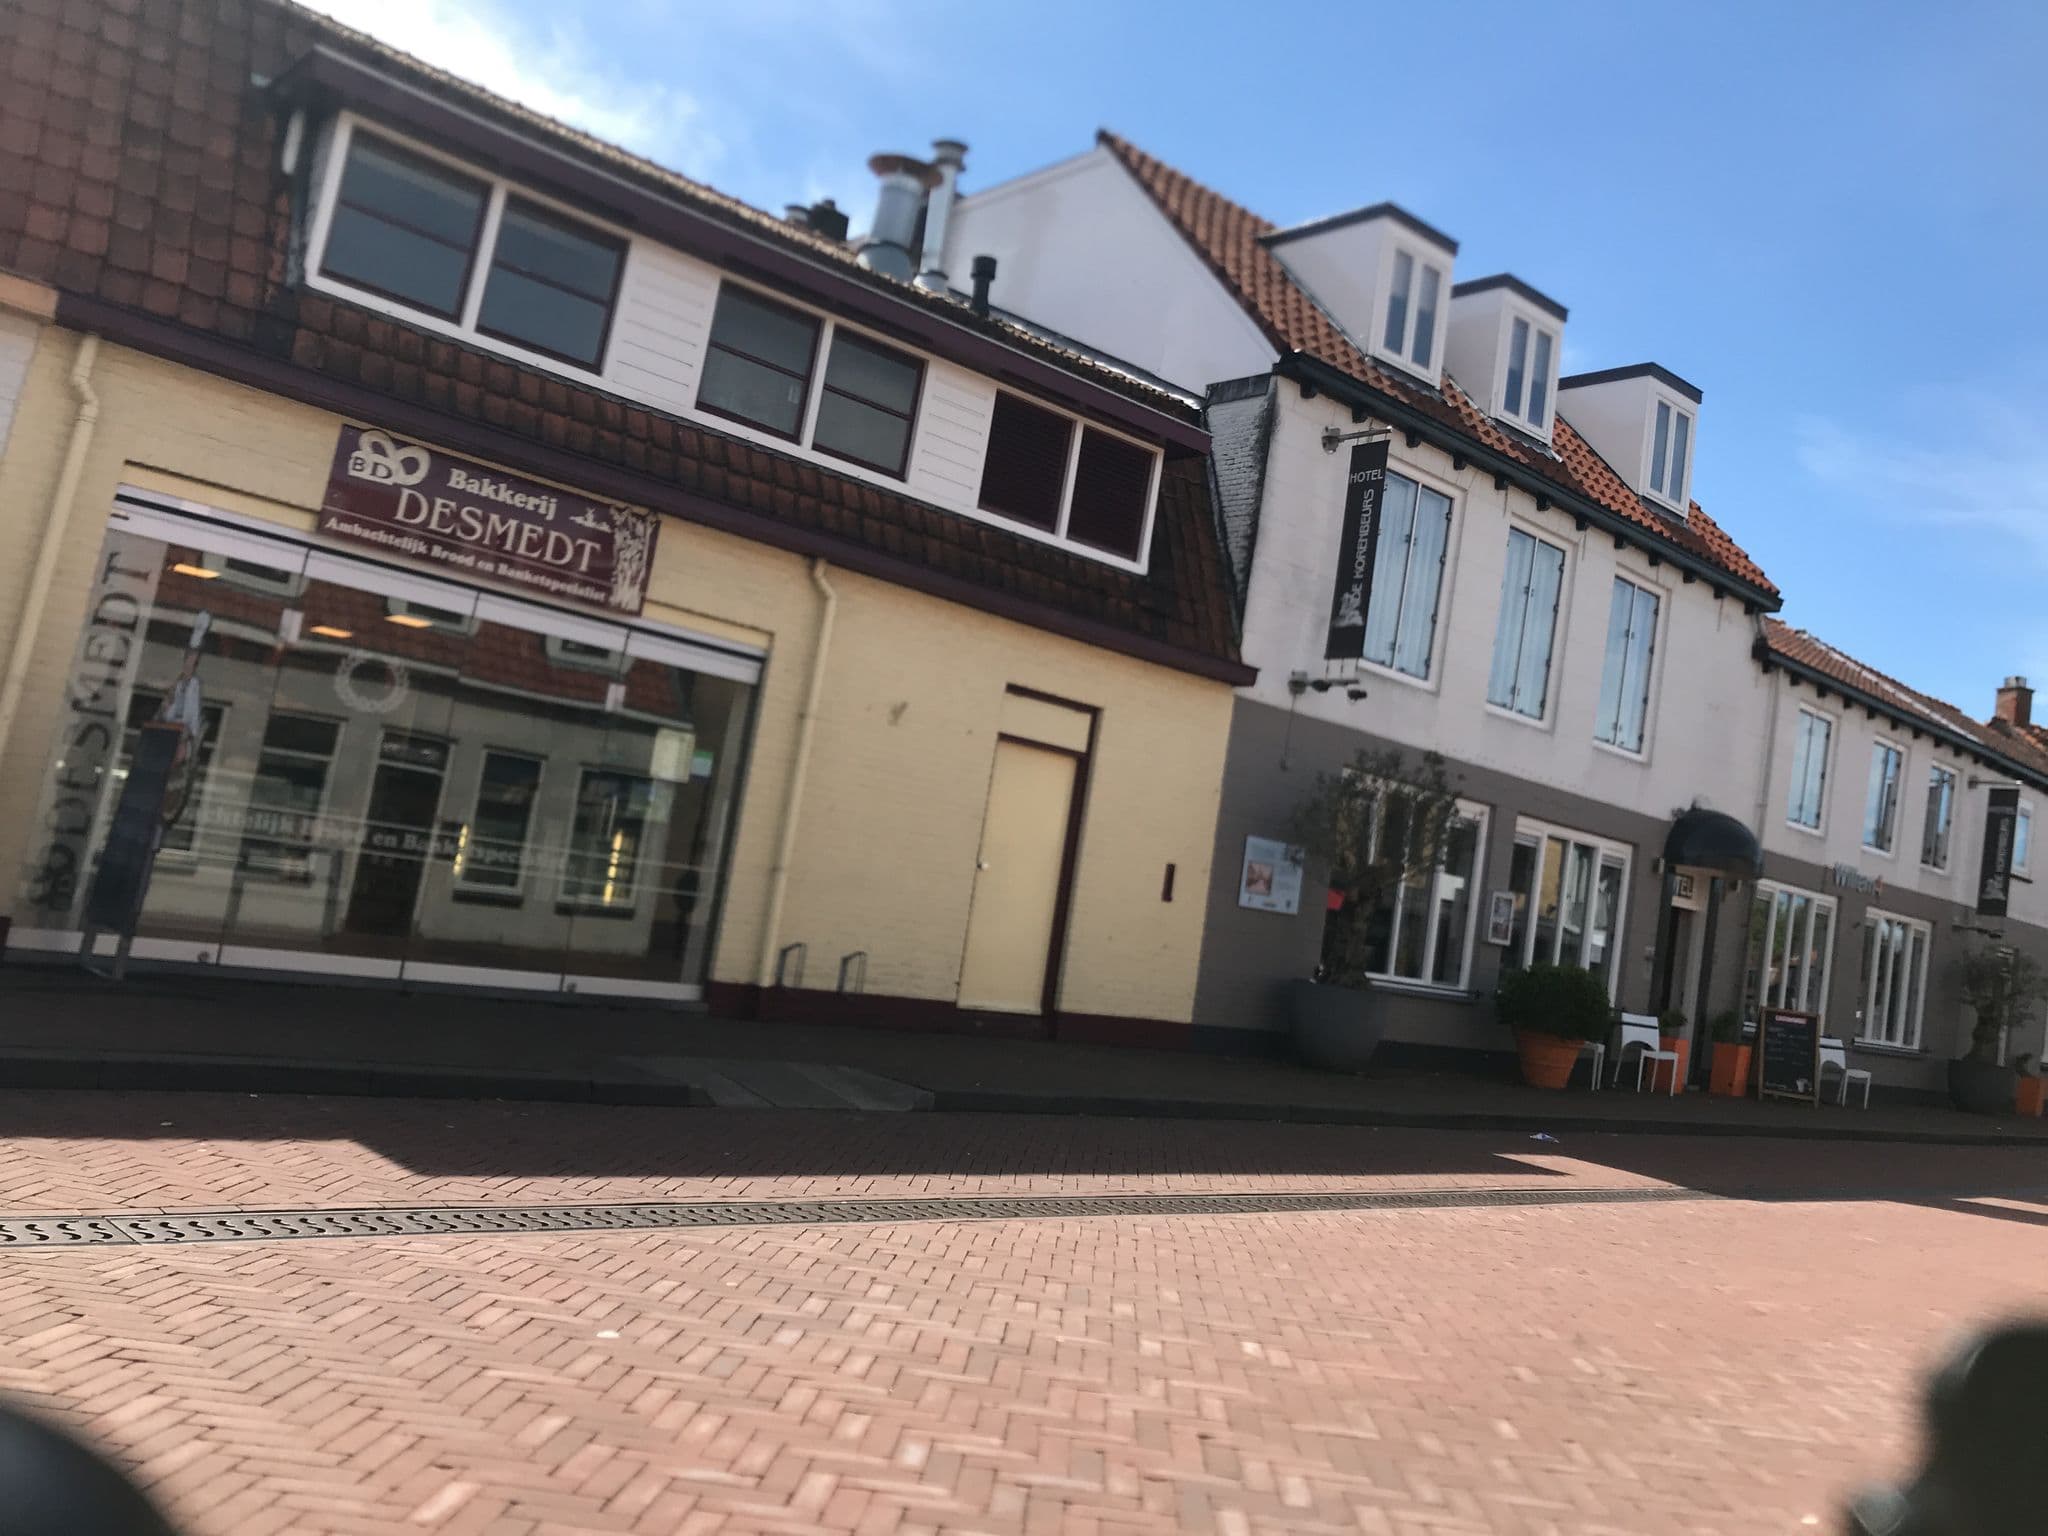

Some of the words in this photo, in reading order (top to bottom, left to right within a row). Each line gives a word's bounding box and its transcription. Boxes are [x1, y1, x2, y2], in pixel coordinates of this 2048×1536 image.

[447, 467, 559, 521] Bakkerij
[1350, 468, 1384, 485] HOTEL
[325, 515, 428, 556] Ambachtelijk
[430, 543, 475, 569] Brood
[477, 558, 496, 573] en
[394, 486, 602, 573] DESMEDT
[48, 551, 151, 838] DESMEDT
